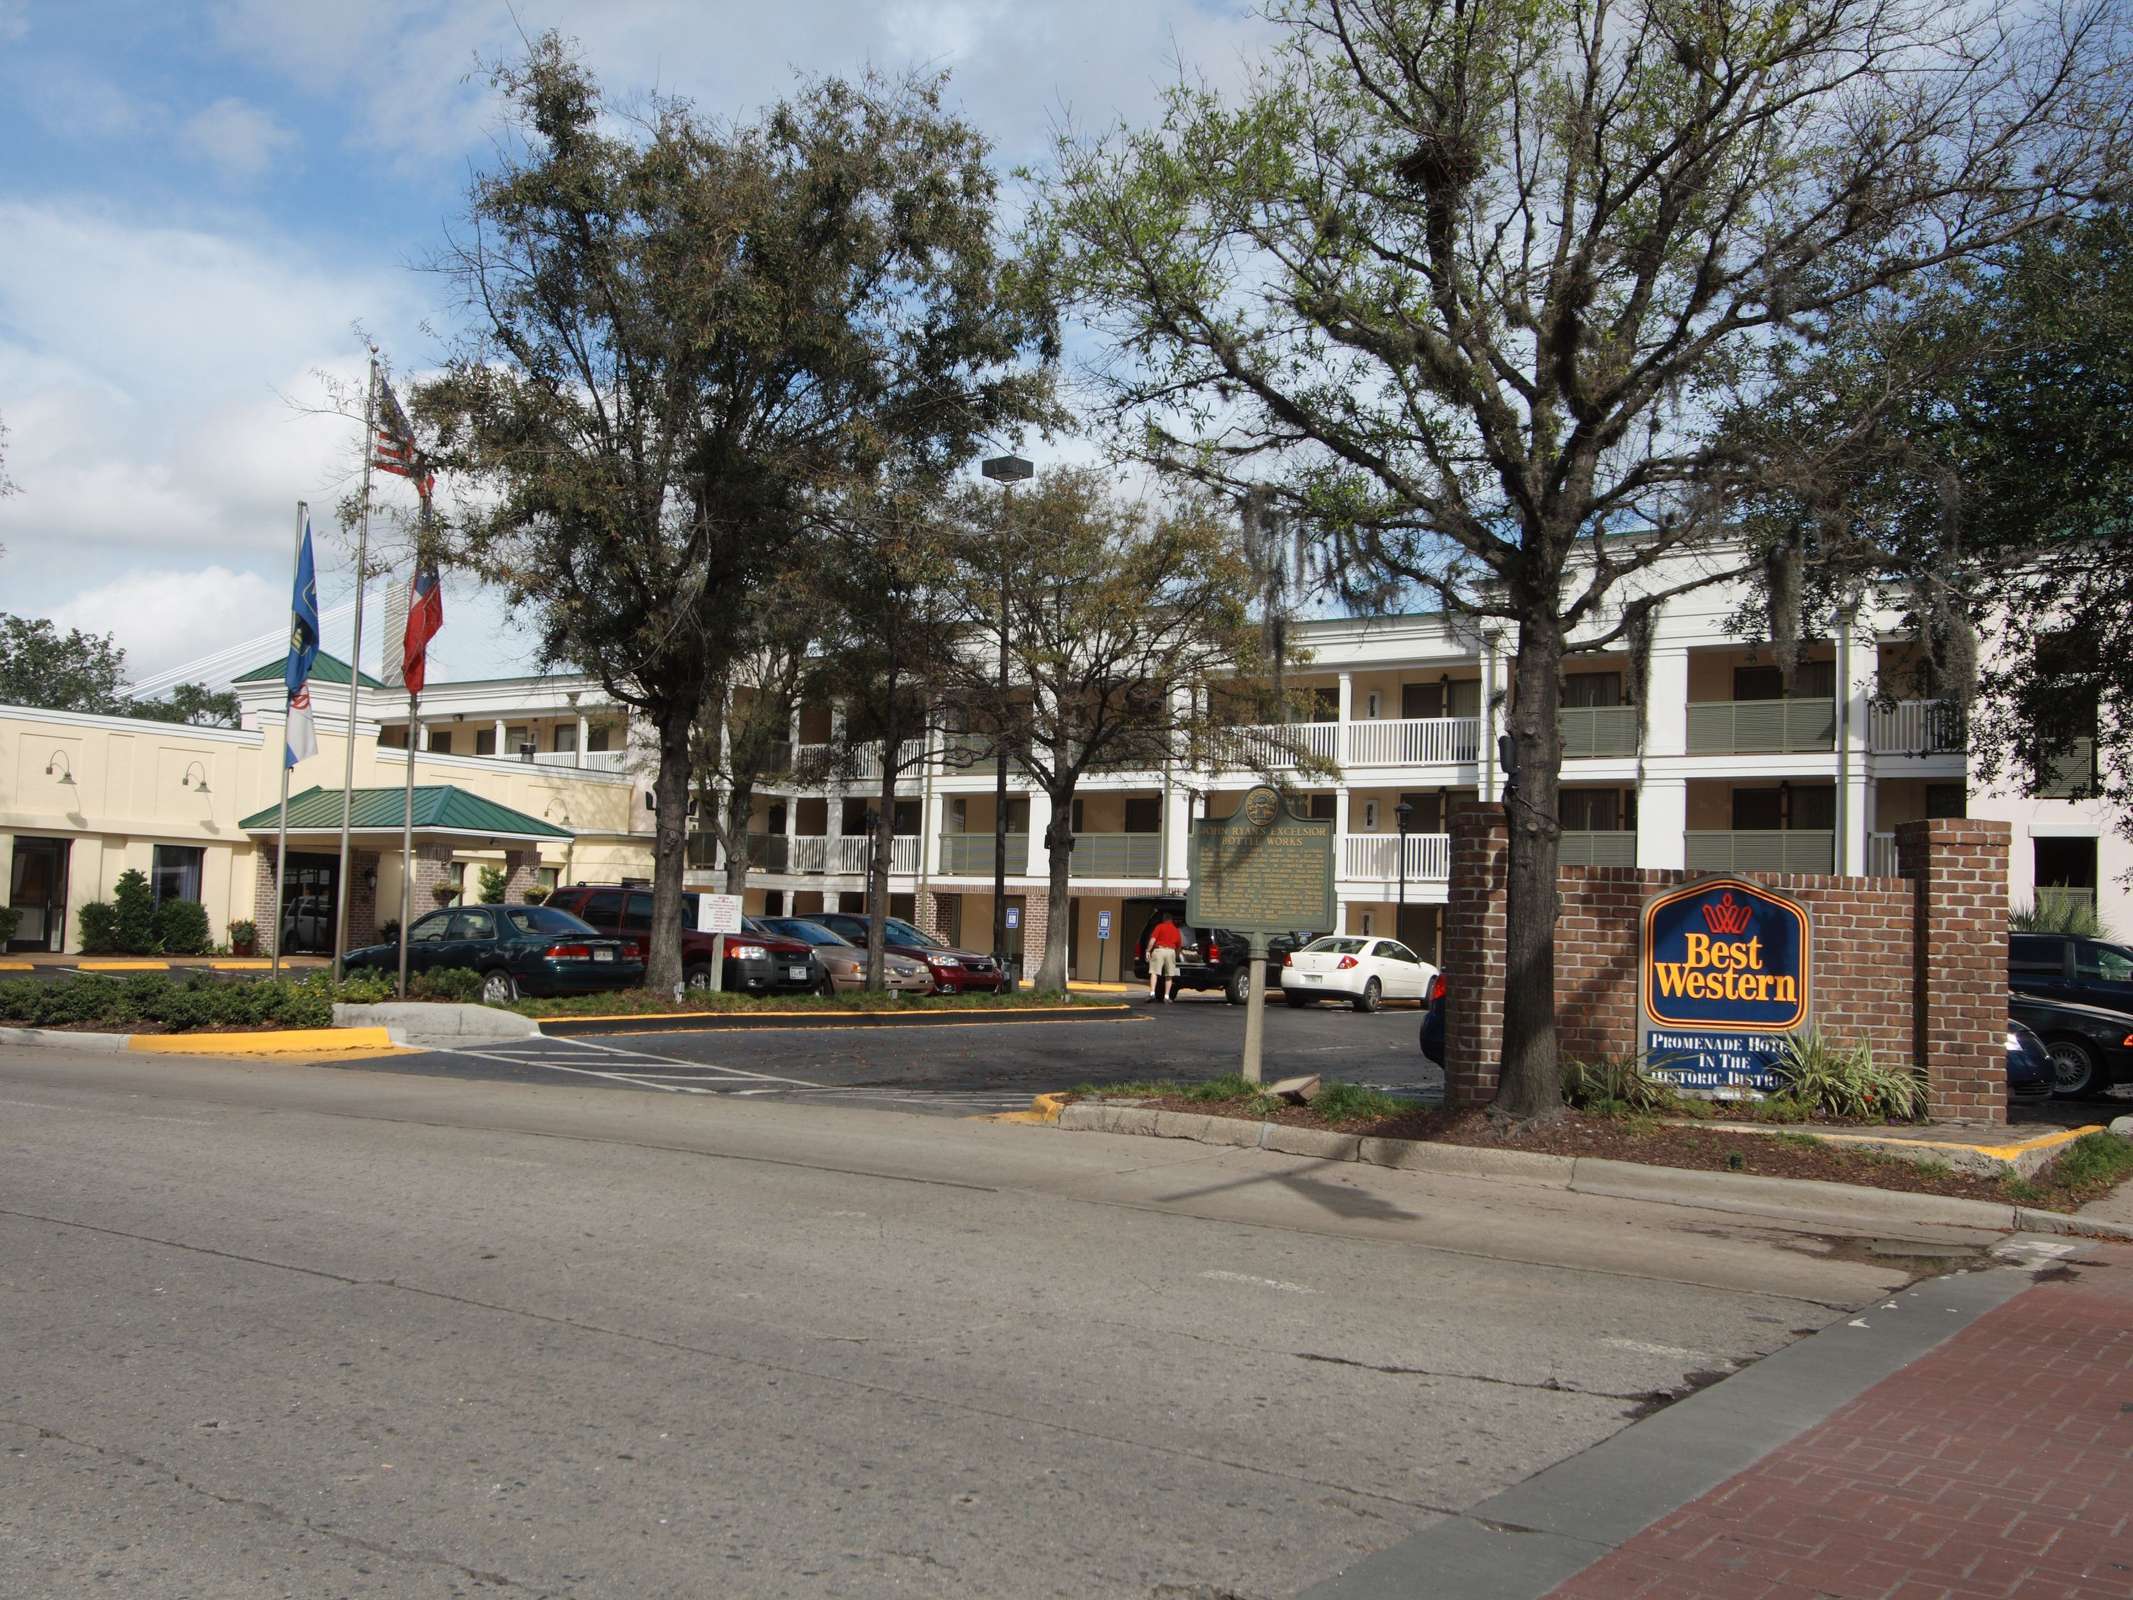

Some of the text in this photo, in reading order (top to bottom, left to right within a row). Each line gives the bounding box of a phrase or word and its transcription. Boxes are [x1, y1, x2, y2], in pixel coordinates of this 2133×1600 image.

[1271, 827, 1327, 836] EXCELSIOR
[1222, 837, 1303, 846] BOTTLE WORKS
[1684, 933, 1763, 970] Best
[1654, 962, 1797, 1003] Western
[1651, 1032, 1790, 1053] PROMENADE HOTE
[1699, 1053, 1751, 1069] IN THE
[1651, 1071, 1722, 1085] HITORIC
